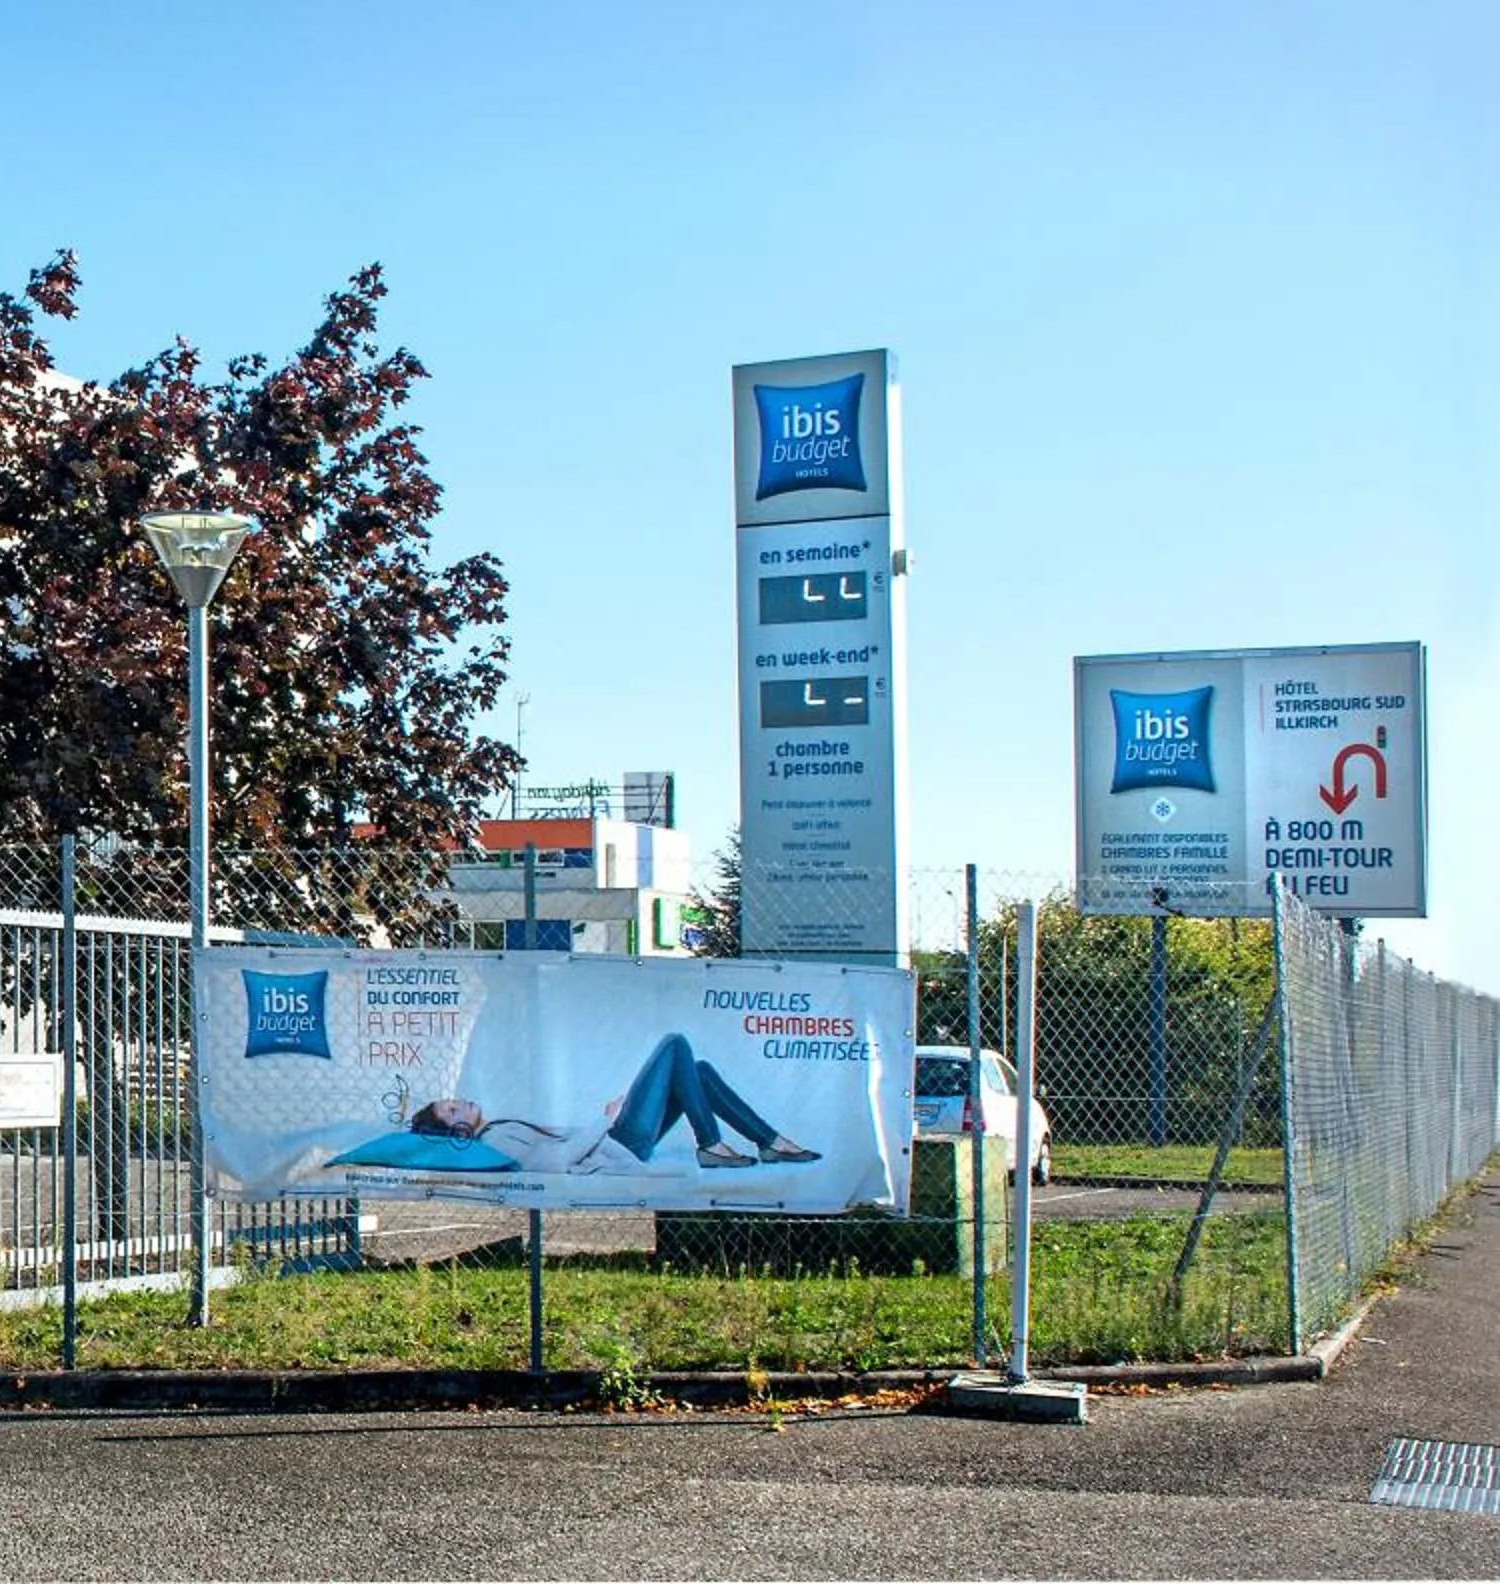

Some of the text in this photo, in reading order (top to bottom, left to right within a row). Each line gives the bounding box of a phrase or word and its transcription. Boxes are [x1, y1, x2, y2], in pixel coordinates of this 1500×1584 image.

[783, 403, 841, 438] ibis
[771, 435, 850, 465] budget
[795, 468, 829, 478] HOTELS
[759, 550, 781, 565] en
[756, 654, 777, 667] en
[1275, 680, 1319, 696] HÔTEL
[1275, 695, 1405, 713] STRASBOURG SUD
[1135, 708, 1189, 740] ibis
[1275, 715, 1338, 729] ILLKIRCH
[775, 740, 850, 757] chambre
[1125, 739, 1199, 765] budget
[768, 760, 864, 779] 1 personne
[1265, 816, 1279, 840] À
[1288, 820, 1333, 840] 800
[1101, 845, 1229, 859] CHAMBRES FAMILLE
[1265, 847, 1393, 868] DEMI-TOUR
[1306, 875, 1348, 895] FEU
[366, 967, 460, 986] L'ESSENTIEL
[263, 986, 309, 1013] ibis
[367, 991, 460, 1005] DU CONFORT
[703, 989, 812, 1013] NOUVELLES
[256, 1013, 316, 1035] budget
[367, 1005, 460, 1037] À PETIT
[743, 1015, 854, 1037] CHAMBRES
[368, 1041, 423, 1067] PRIX
